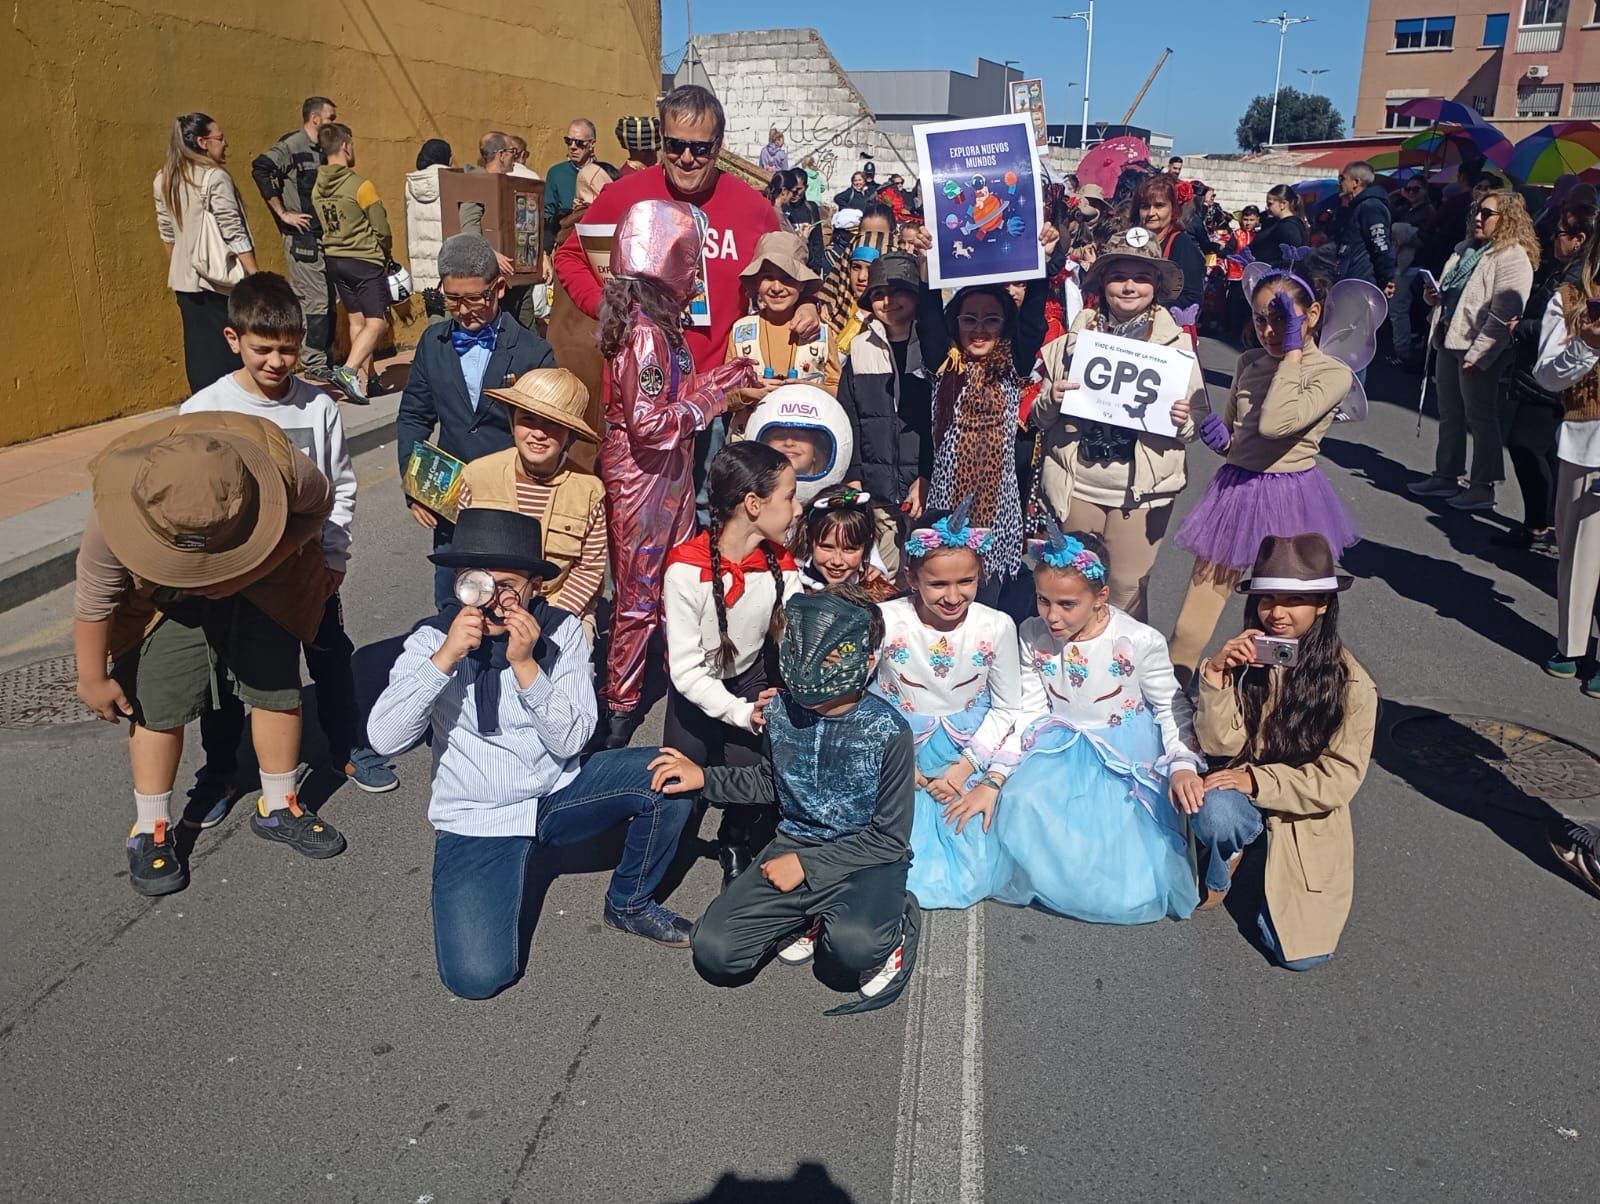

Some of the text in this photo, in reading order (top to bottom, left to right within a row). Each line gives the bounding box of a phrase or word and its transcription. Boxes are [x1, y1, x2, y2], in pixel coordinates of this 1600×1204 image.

[950, 142, 1010, 158] EXPLORA NUEVOS
[965, 155, 997, 168] MUNDOS
[1084, 357, 1161, 404] GPS
[780, 403, 819, 417] NASA
